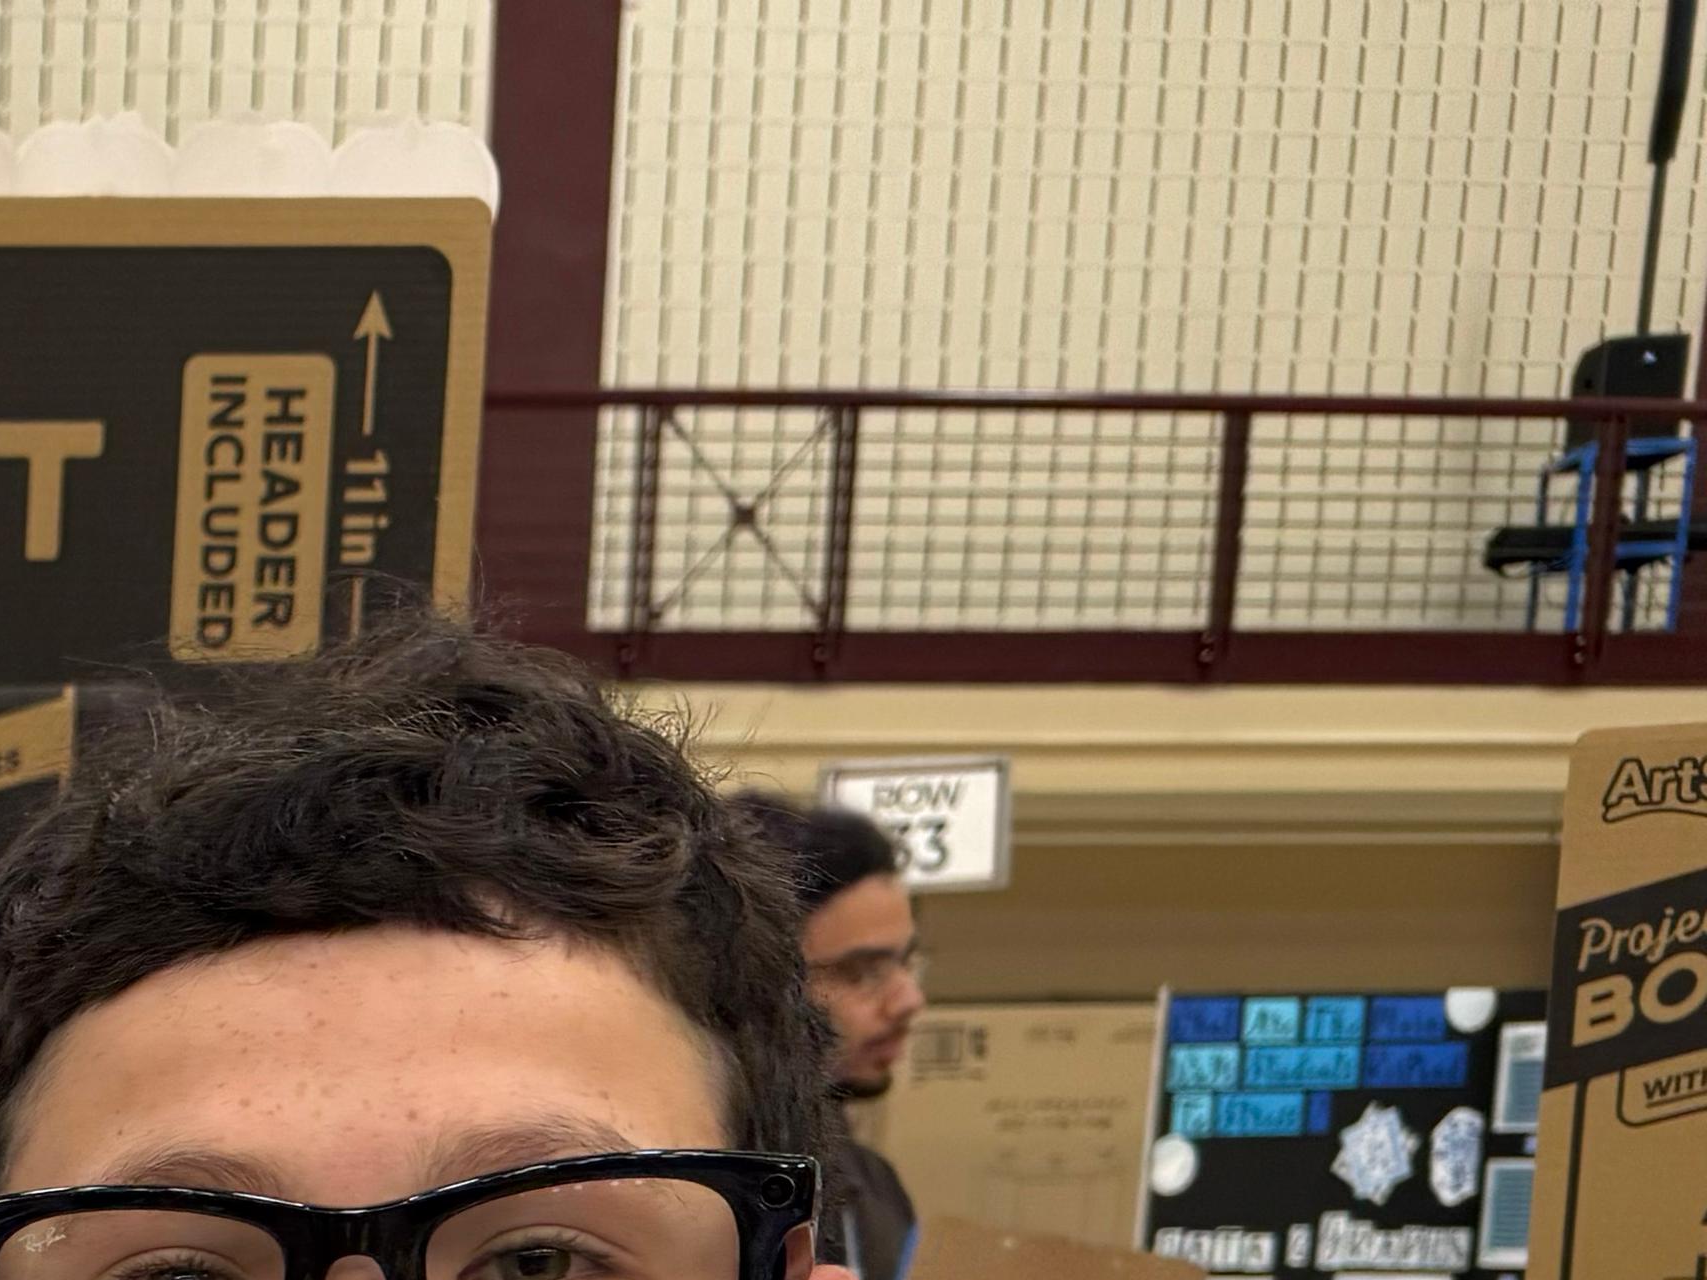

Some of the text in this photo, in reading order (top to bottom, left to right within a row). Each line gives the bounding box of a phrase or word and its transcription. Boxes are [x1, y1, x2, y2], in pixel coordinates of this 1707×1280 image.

[196, 375, 247, 650] INCLUDED
[252, 388, 306, 628] HEADER
[339, 449, 390, 564] 11 in
[873, 777, 967, 812] ROW
[1578, 907, 1707, 972] Proje
